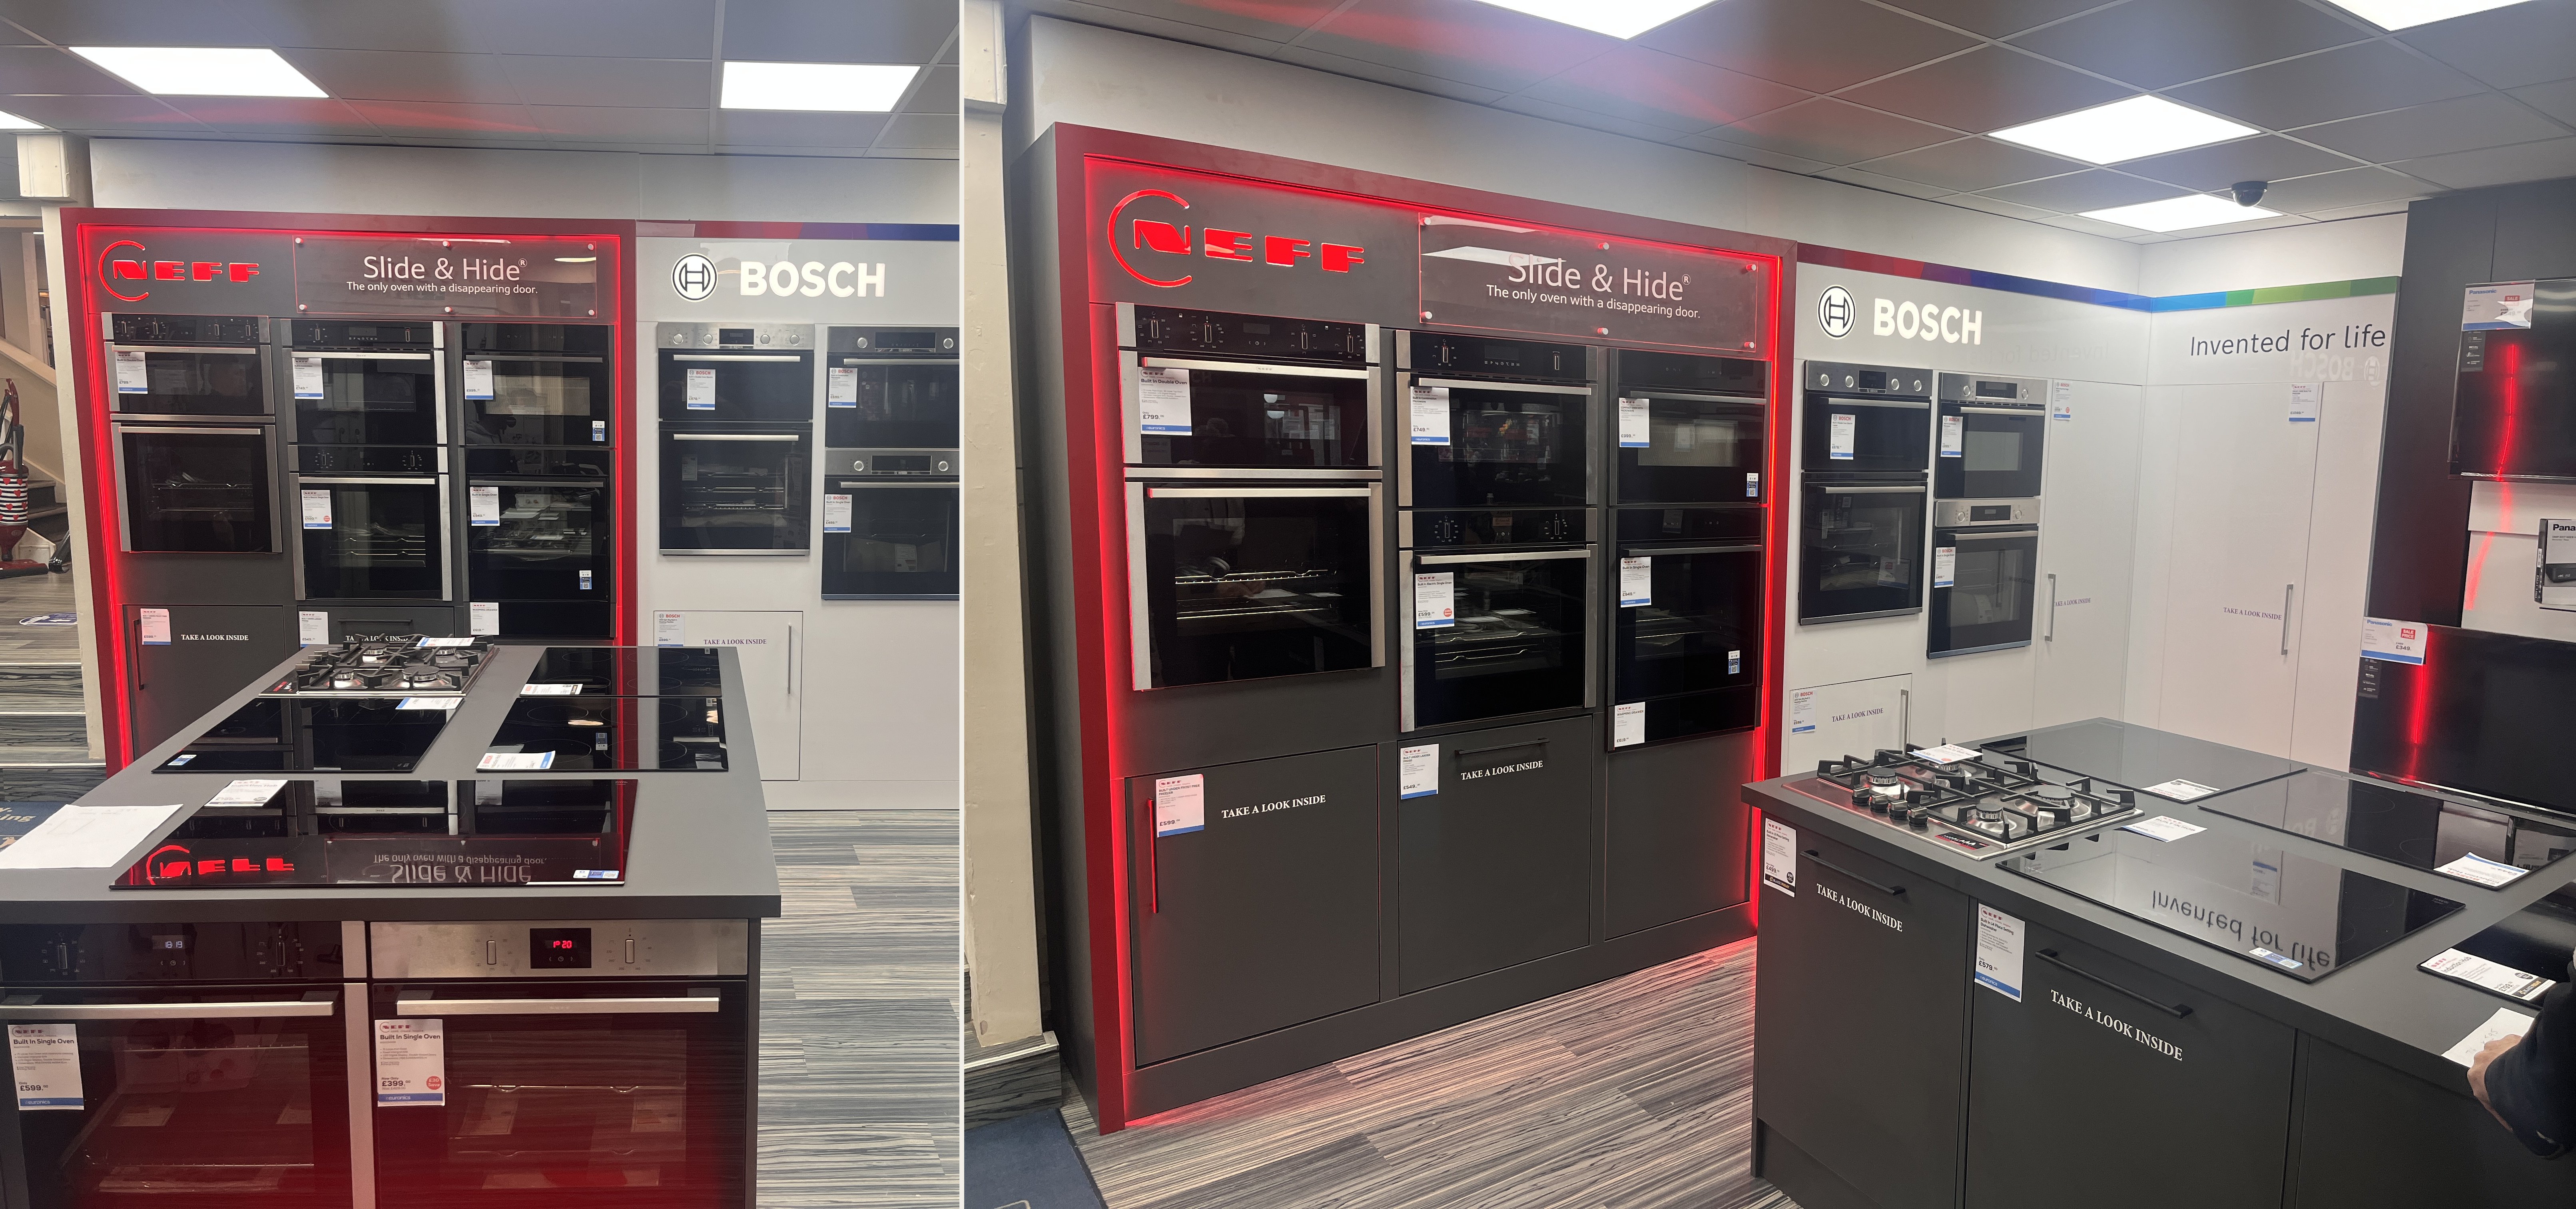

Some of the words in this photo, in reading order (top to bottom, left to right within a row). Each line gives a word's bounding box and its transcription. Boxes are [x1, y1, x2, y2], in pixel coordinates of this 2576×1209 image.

[363, 256, 425, 279] Slide
[435, 257, 453, 280] &
[740, 261, 885, 297] BOSCH
[1508, 253, 1581, 289] Slide
[1591, 264, 1613, 292] &
[347, 281, 365, 291] The
[367, 281, 388, 293] only
[416, 283, 437, 292] with
[449, 283, 510, 295] disappearing
[513, 285, 538, 294] door.
[1486, 284, 1509, 297] The
[1512, 288, 1537, 303] only
[1540, 294, 1567, 304] oven
[1570, 295, 1594, 307] with
[1597, 299, 1604, 308] a
[1607, 298, 1672, 318] disappearing
[1675, 305, 1701, 319] door.
[1873, 297, 1982, 345] BOSCH
[2191, 329, 2290, 356] Invented
[2301, 328, 2336, 350] for
[2344, 324, 2386, 348] life
[1866, 708, 1884, 716] INSIDE
[1461, 770, 1483, 780] TAKE
[1492, 764, 1515, 776] LOOK
[1516, 760, 1543, 771] INSIDE
[1221, 806, 1250, 819] TAKE
[1252, 805, 1259, 814] A
[1262, 800, 1290, 812] LOOK
[1292, 794, 1326, 808] INSIDE
[1816, 883, 1838, 902] TAKE
[1839, 895, 1845, 905] A
[1846, 897, 1871, 917] LOOK
[1872, 908, 1903, 932] INSIDE
[1980, 922, 1997, 932] Dishwasher
[2003, 926, 2014, 936] Setting
[2442, 960, 2460, 974] Induction
[2460, 956, 2472, 966] Hob
[2051, 989, 2082, 1014] TAKE
[2084, 1006, 2094, 1020] A
[2096, 1010, 2133, 1038] LOOK
[2135, 1028, 2183, 1061] INSIDE
